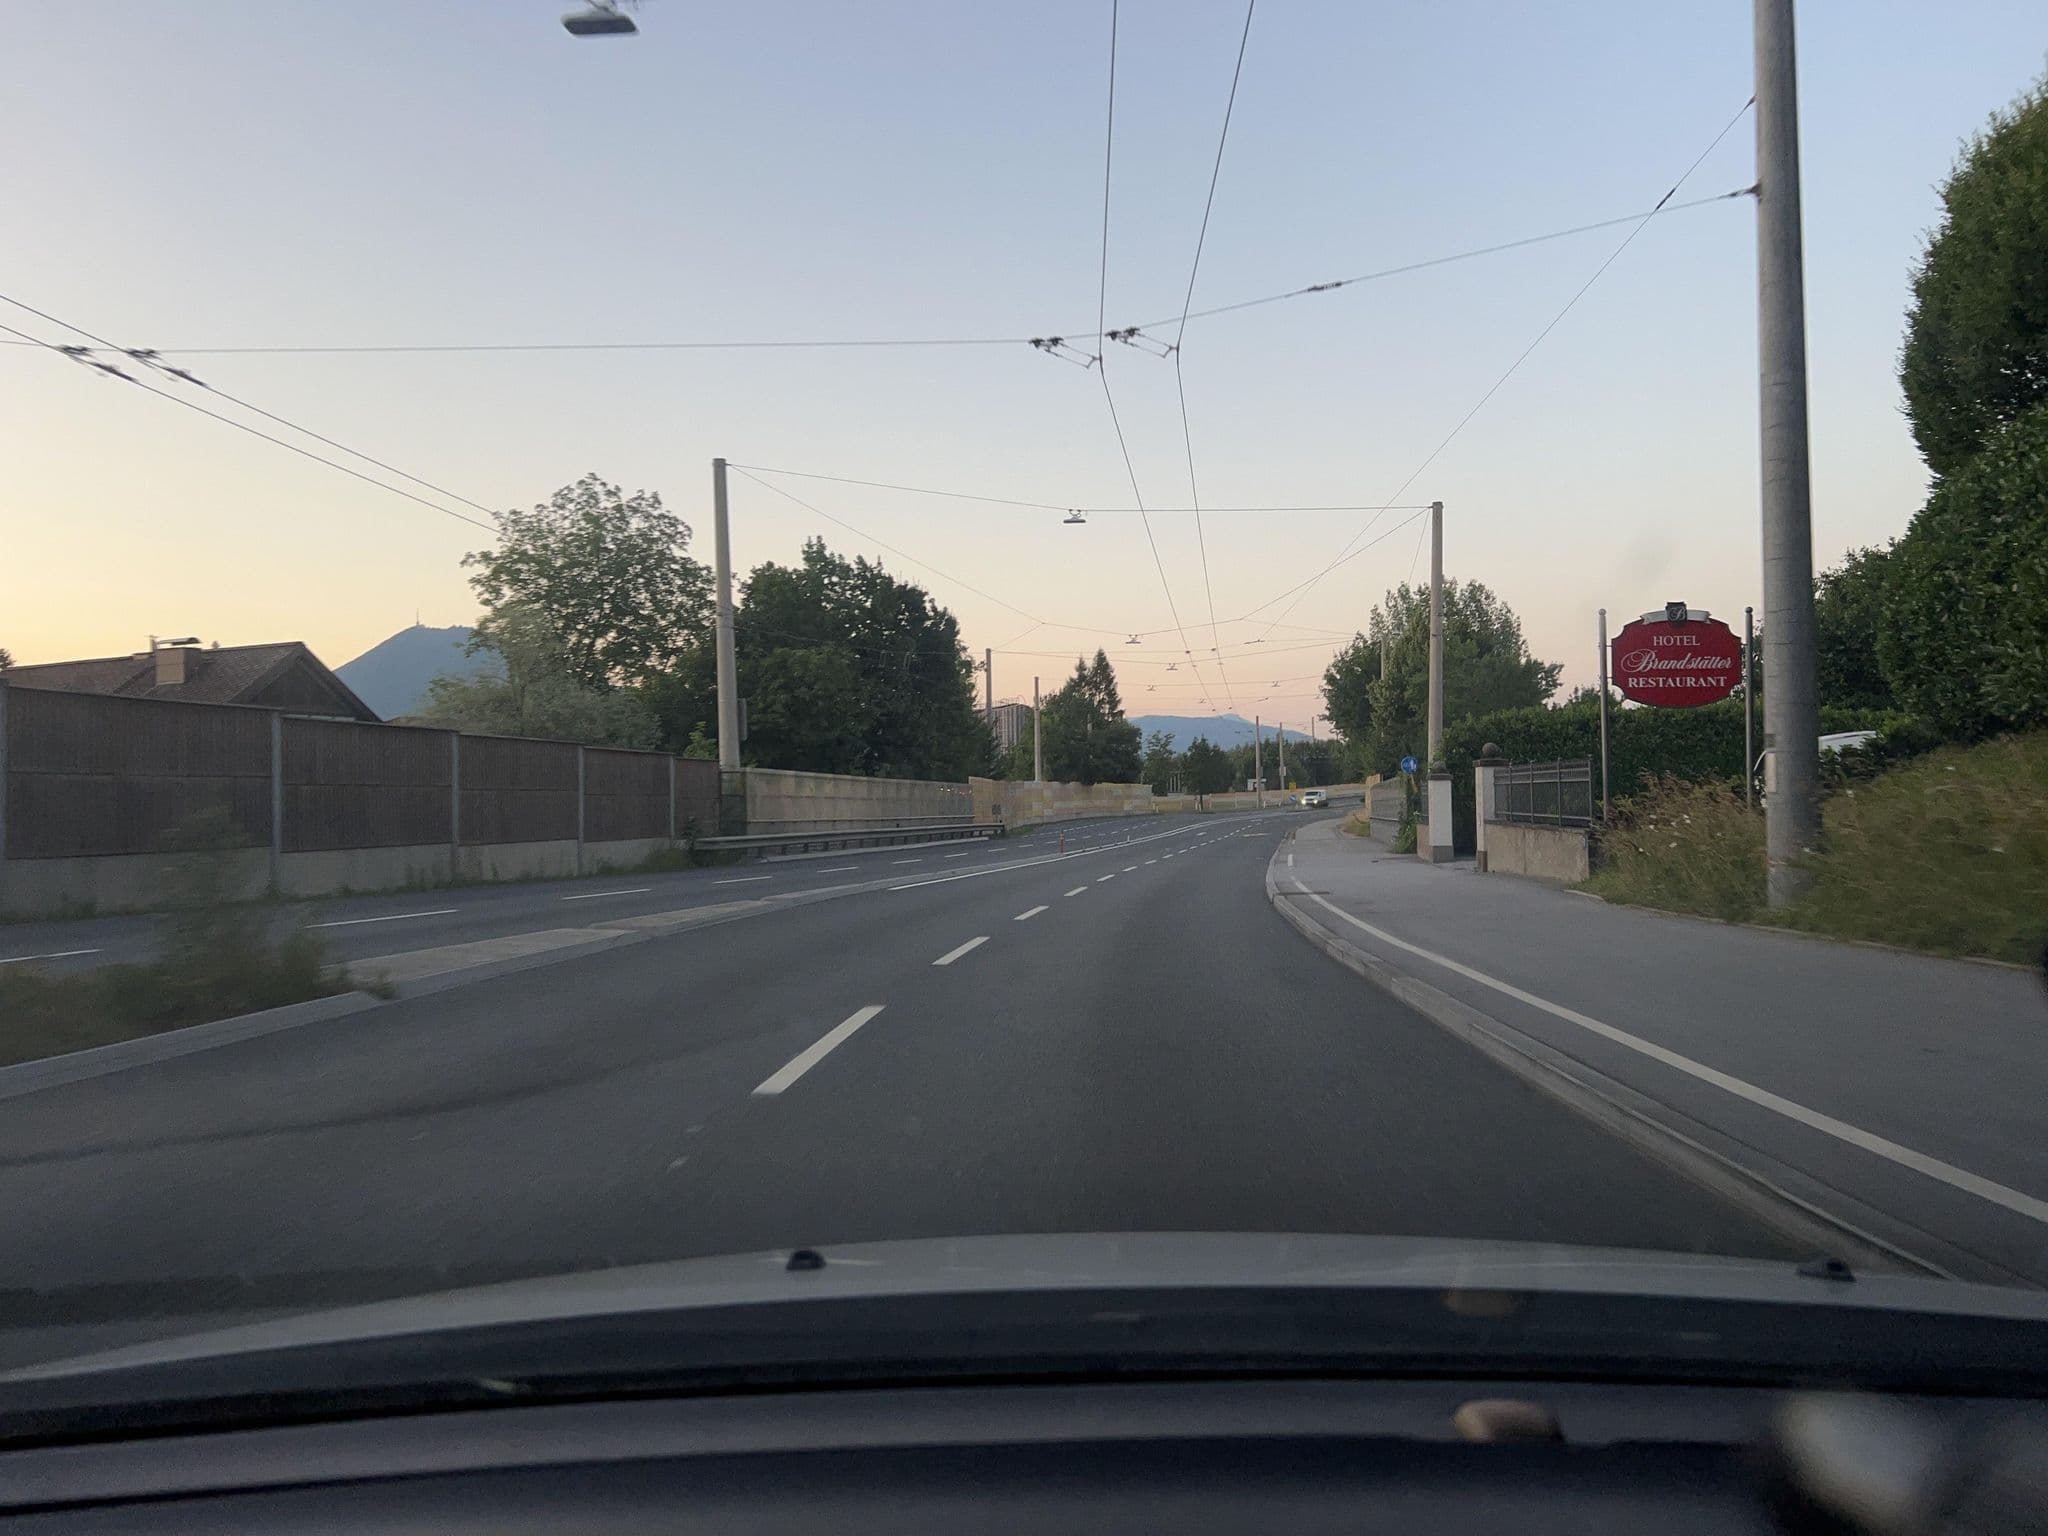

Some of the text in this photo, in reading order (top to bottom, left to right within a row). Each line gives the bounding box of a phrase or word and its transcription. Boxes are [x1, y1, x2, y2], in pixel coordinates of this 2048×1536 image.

[1653, 635, 1700, 646] HOTEL
[1620, 648, 1732, 673] Brandstätter
[1628, 676, 1727, 688] RESTAURANT
